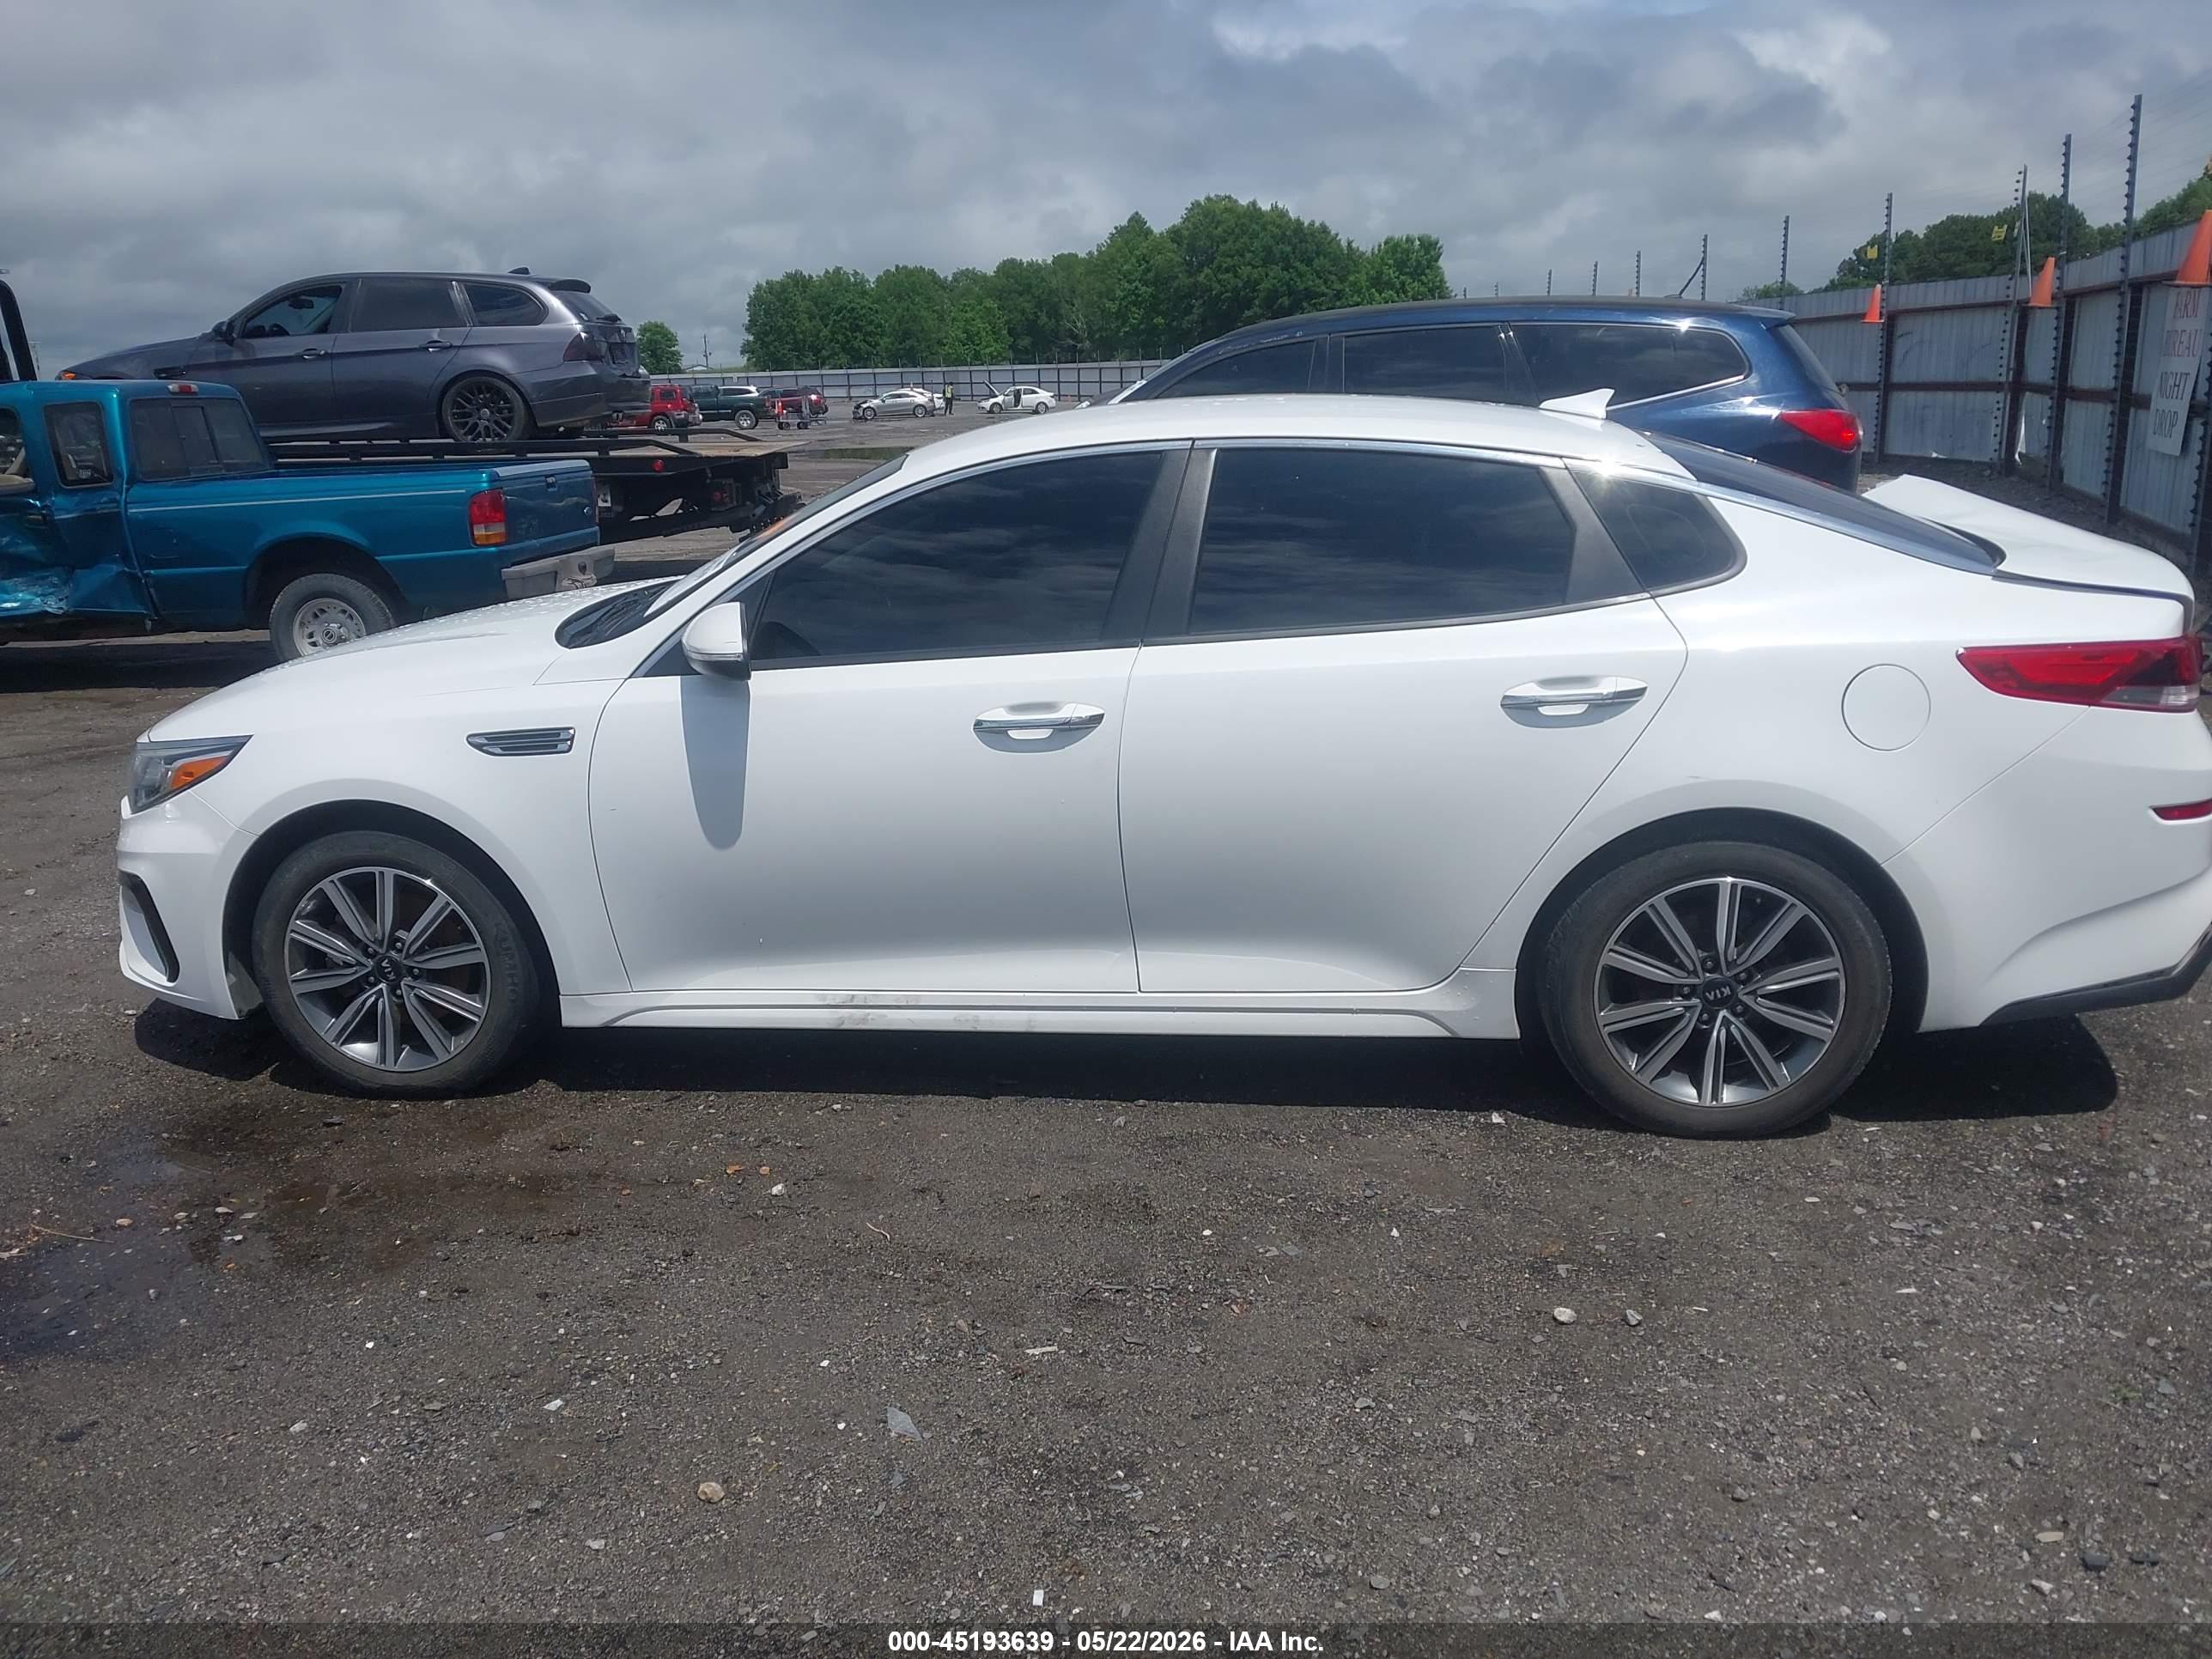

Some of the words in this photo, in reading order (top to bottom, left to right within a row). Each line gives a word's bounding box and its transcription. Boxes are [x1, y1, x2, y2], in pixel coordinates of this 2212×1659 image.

[2156, 371, 2191, 400] NIGHT
[2153, 408, 2179, 439] DROP
[1705, 985, 1731, 1000] KIA
